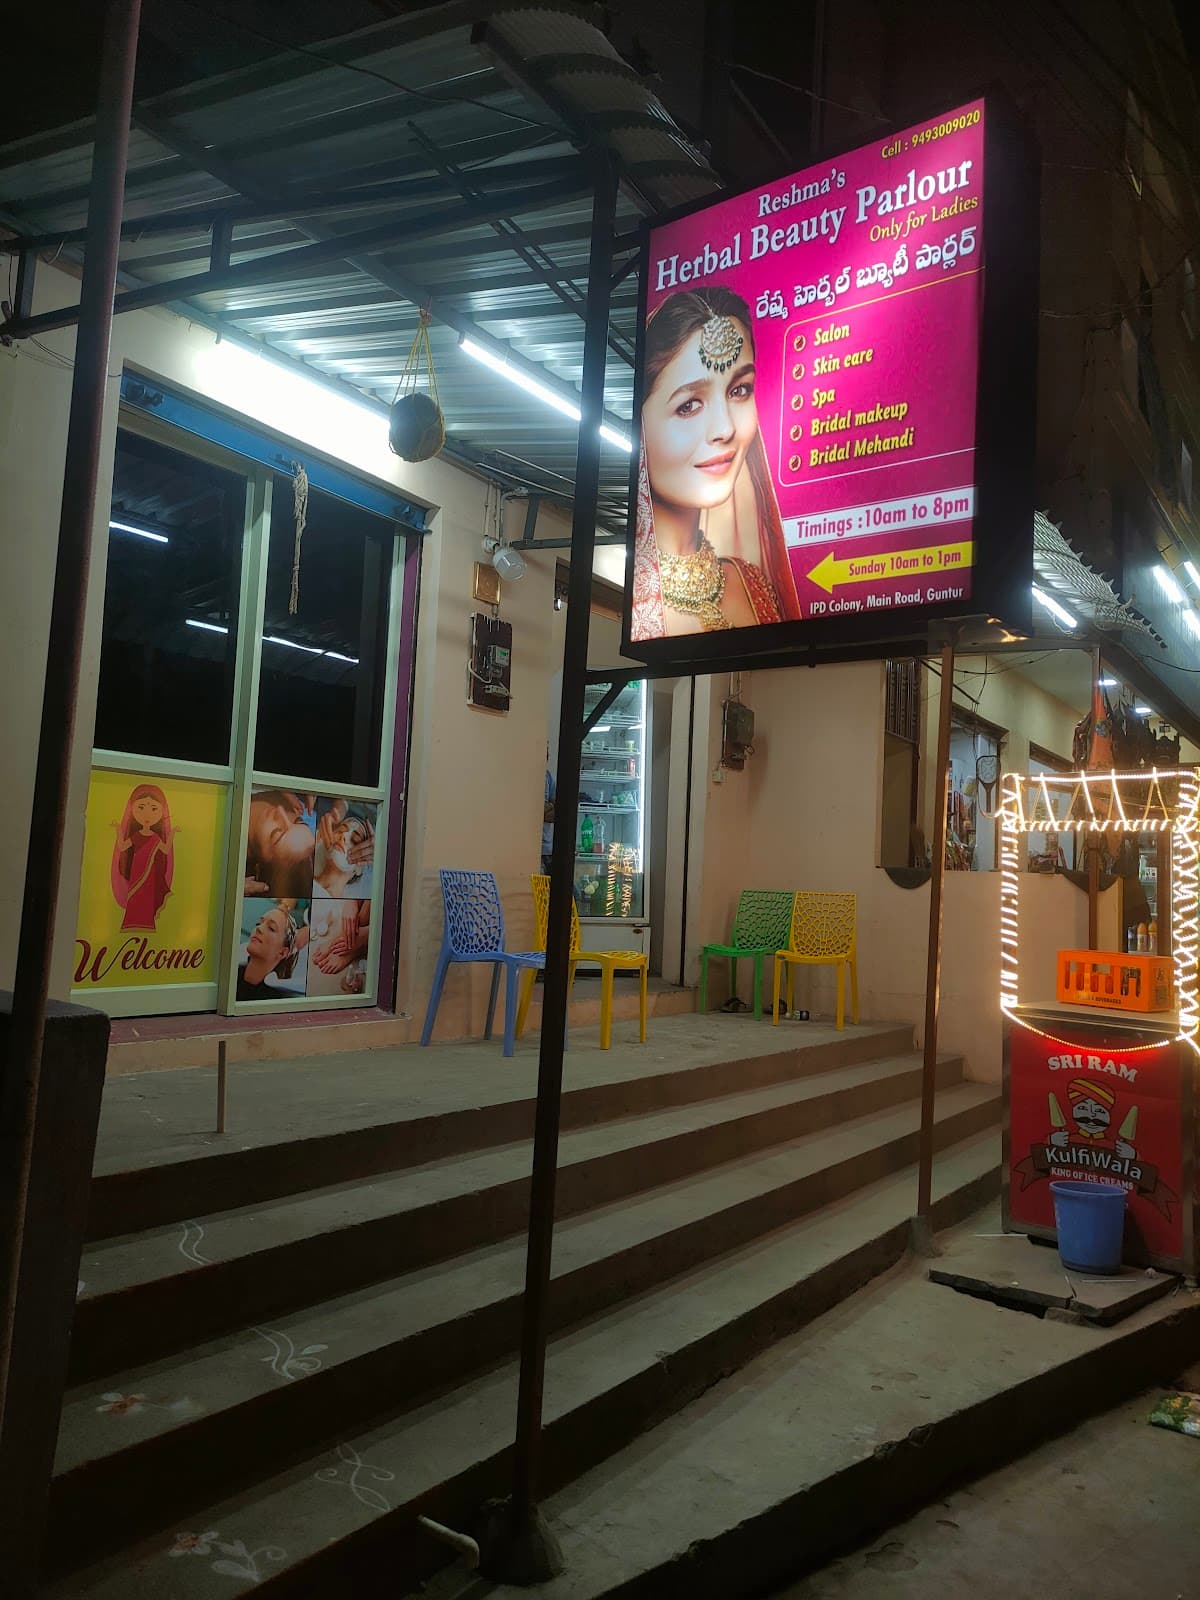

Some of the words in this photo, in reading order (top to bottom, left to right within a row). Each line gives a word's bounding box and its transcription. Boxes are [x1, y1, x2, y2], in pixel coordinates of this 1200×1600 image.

[880, 140, 901, 159] Cell
[911, 110, 981, 147] 9493009020
[654, 232, 741, 292] Herbal
[749, 205, 846, 262] Beauty
[854, 159, 972, 224] Parlour
[869, 218, 903, 242] Only
[902, 211, 928, 239] for
[931, 195, 978, 222] Ladies
[813, 323, 850, 346] Salon
[812, 353, 841, 376] Skin
[843, 348, 874, 368] care
[811, 388, 836, 409] Spa
[810, 409, 852, 437] Bridal
[854, 402, 908, 427] makeup
[809, 440, 850, 468] Bridal
[853, 427, 915, 458] Mehandi
[796, 517, 853, 539] Timings
[911, 503, 928, 519] to
[933, 496, 969, 519] 8pm
[849, 560, 886, 577] Sunday
[890, 556, 919, 571] 10am
[922, 553, 933, 566] to
[937, 550, 961, 567] 1pm
[809, 602, 827, 615] IPD
[829, 598, 864, 613] Colony,
[866, 594, 892, 609] Main
[894, 588, 924, 605] Road,
[926, 586, 964, 601] Guntur
[73, 936, 206, 983] Welcome
[1047, 1054, 1083, 1071] SRI
[1087, 1055, 1138, 1083] RAM
[1045, 1146, 1142, 1180] KulfiWala
[1051, 1167, 1072, 1178] KING
[1072, 1170, 1083, 1180] OF
[1084, 1171, 1099, 1184] ICE
[1099, 1175, 1134, 1190] CREAMS
